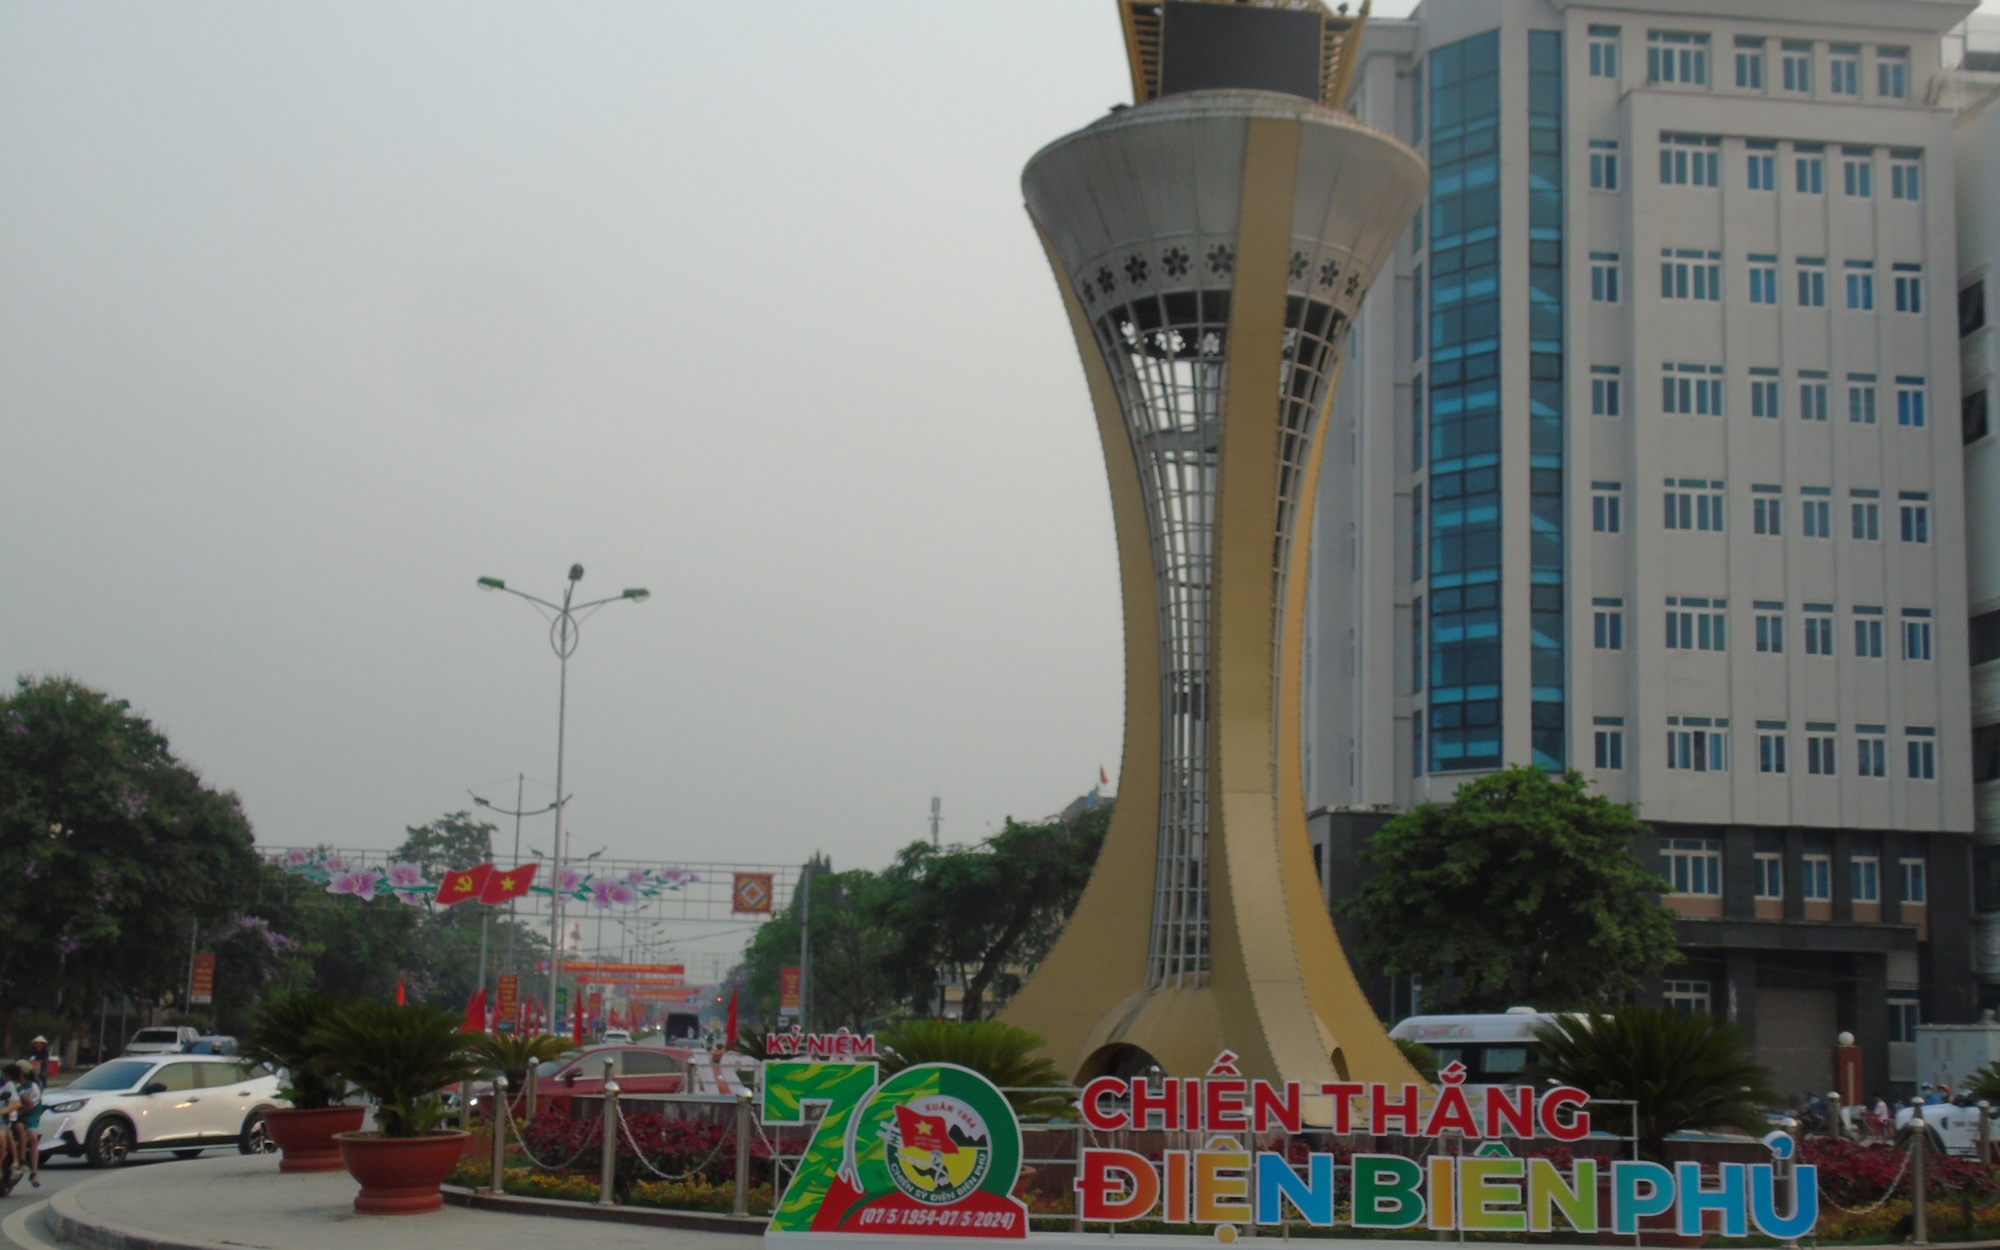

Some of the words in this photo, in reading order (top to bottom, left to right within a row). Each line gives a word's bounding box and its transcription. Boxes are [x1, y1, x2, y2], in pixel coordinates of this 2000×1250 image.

[767, 1025, 804, 1054] KỶ
[807, 1027, 875, 1061] NIỆM
[1080, 1049, 1302, 1135] CHIẾN
[1320, 1060, 1590, 1142] THẮNG
[761, 1060, 1024, 1236] 70
[1074, 1134, 1335, 1244] ĐIỆN
[1351, 1140, 1598, 1234] BIÊN
[1610, 1130, 1819, 1239] PHỦ
